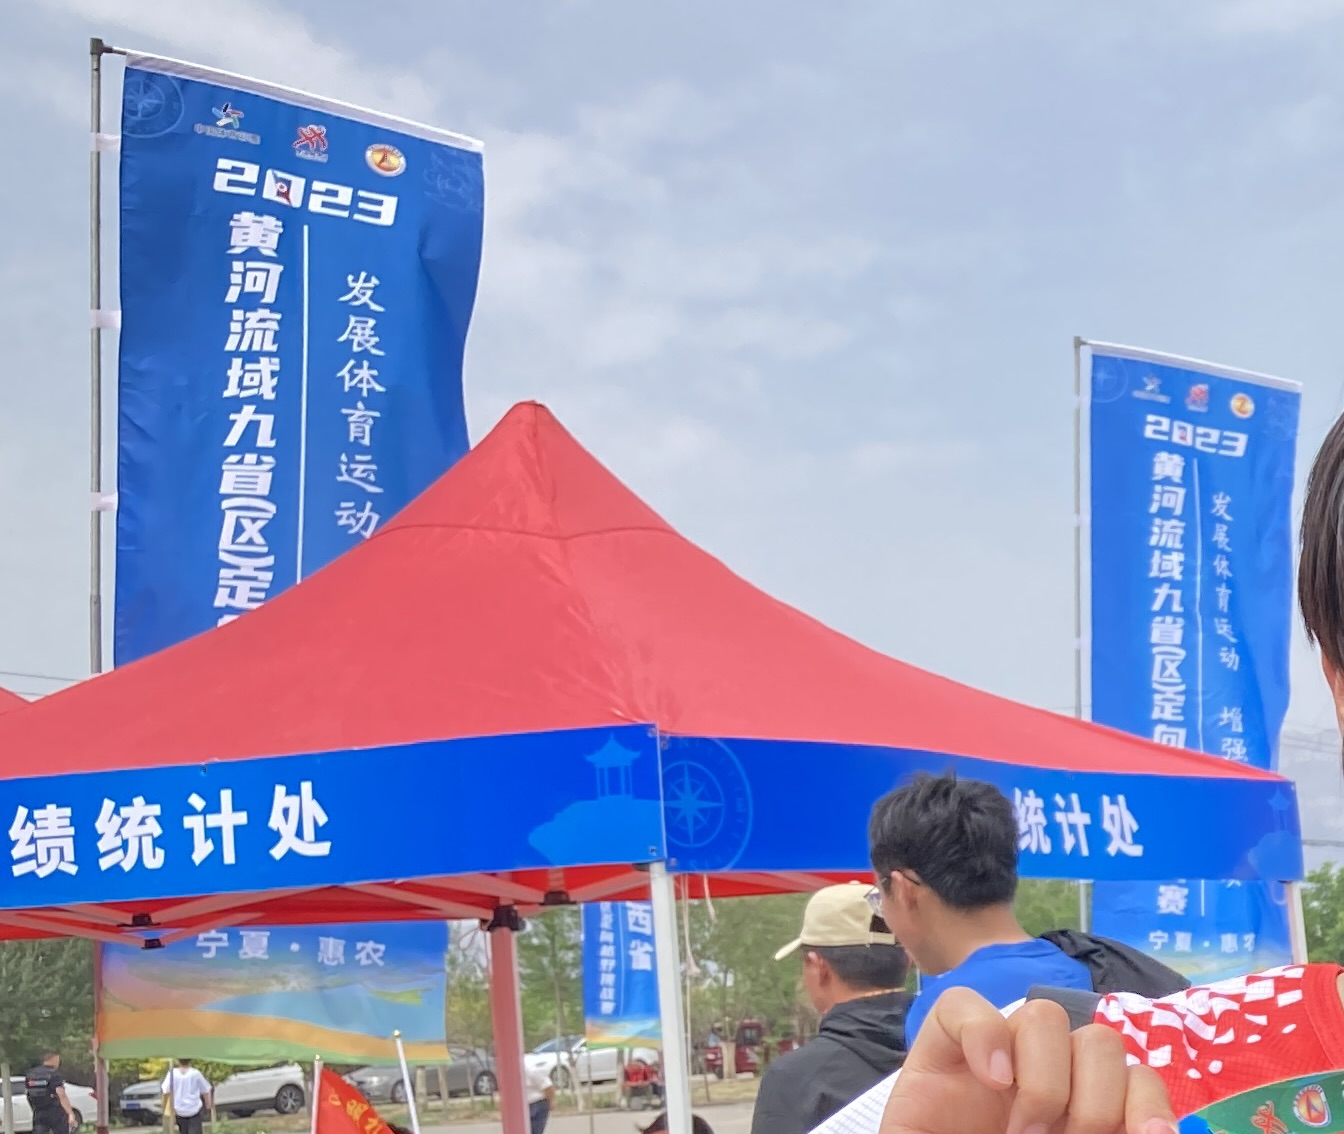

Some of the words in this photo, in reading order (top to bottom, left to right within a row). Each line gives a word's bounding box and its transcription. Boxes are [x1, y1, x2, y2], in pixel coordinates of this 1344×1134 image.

[213, 158, 398, 226] 2023
[335, 271, 386, 539] 发展体育运动
[1144, 414, 1249, 458] 2023
[1210, 490, 1240, 672] 发展体育运动
[9, 780, 332, 879] 绩统计处
[1014, 788, 1143, 857] 统计处
